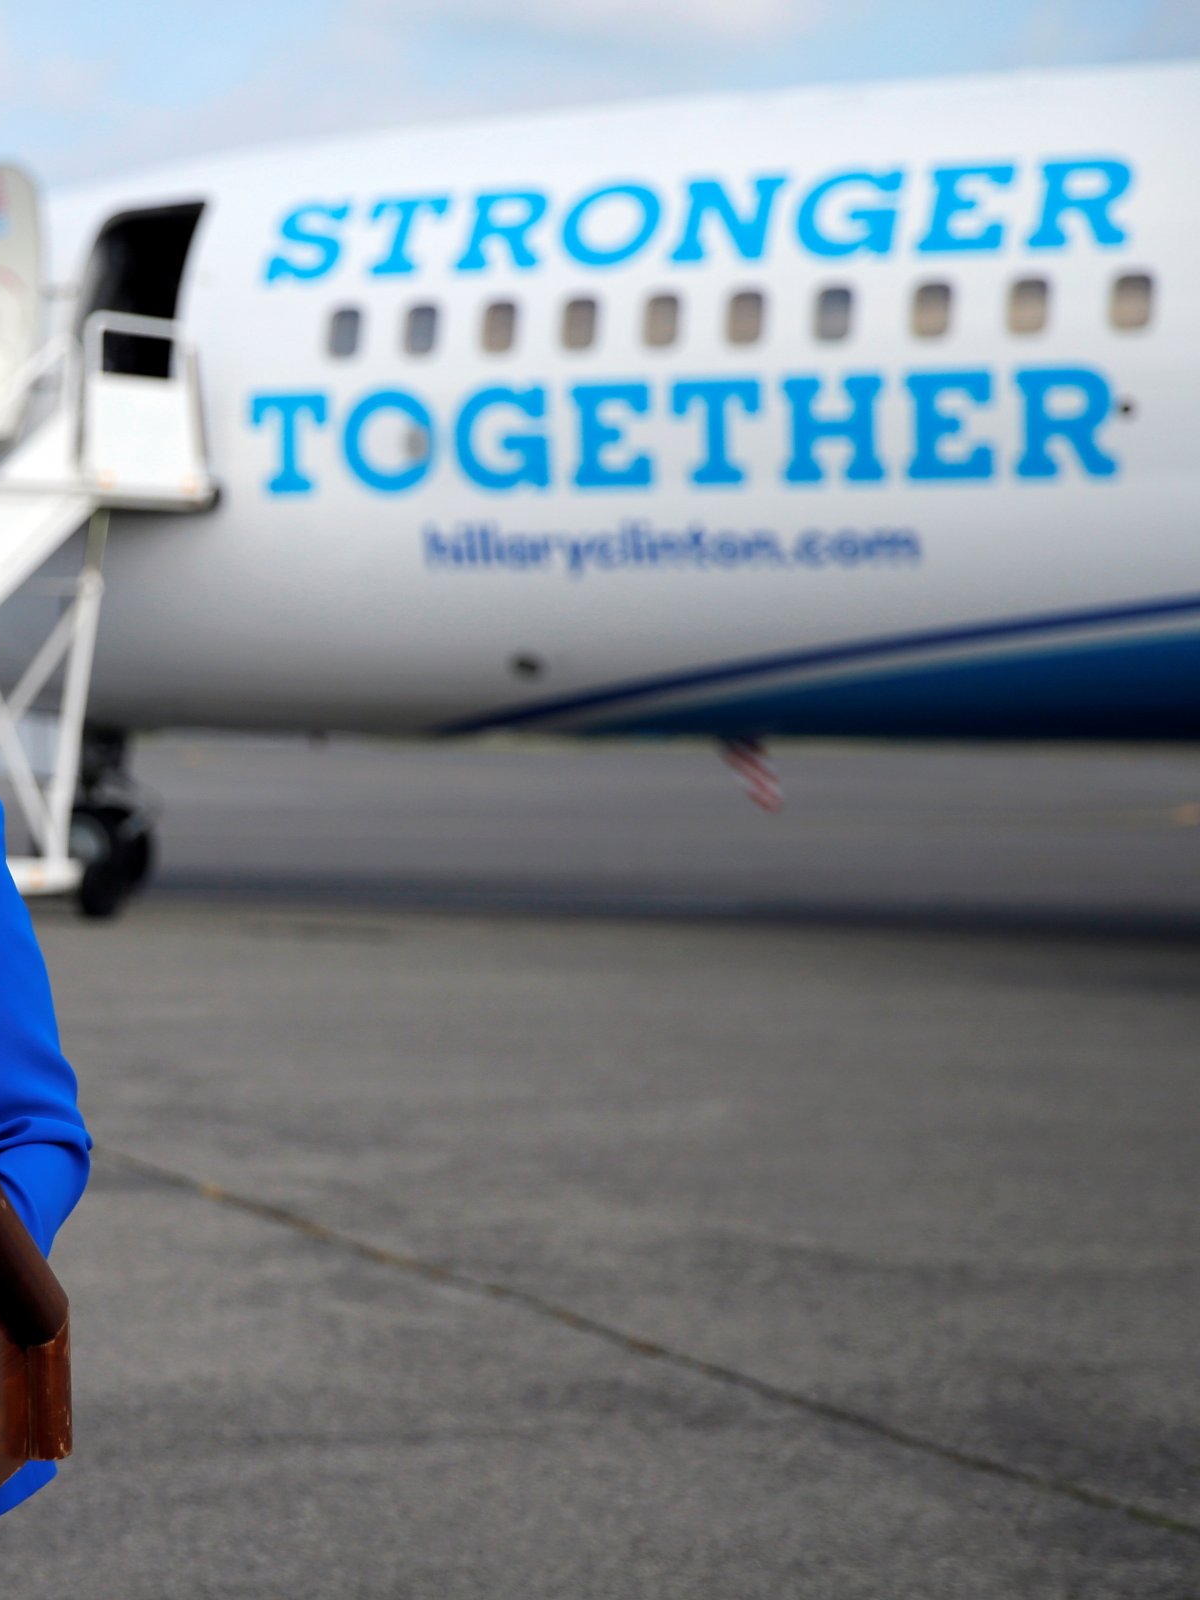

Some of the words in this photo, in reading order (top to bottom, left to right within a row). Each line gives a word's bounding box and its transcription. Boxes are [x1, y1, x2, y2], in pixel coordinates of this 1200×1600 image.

[264, 157, 1133, 284] STRONGER
[250, 365, 1118, 496] TOGETHER
[423, 520, 922, 576] hillaryclinton.com
